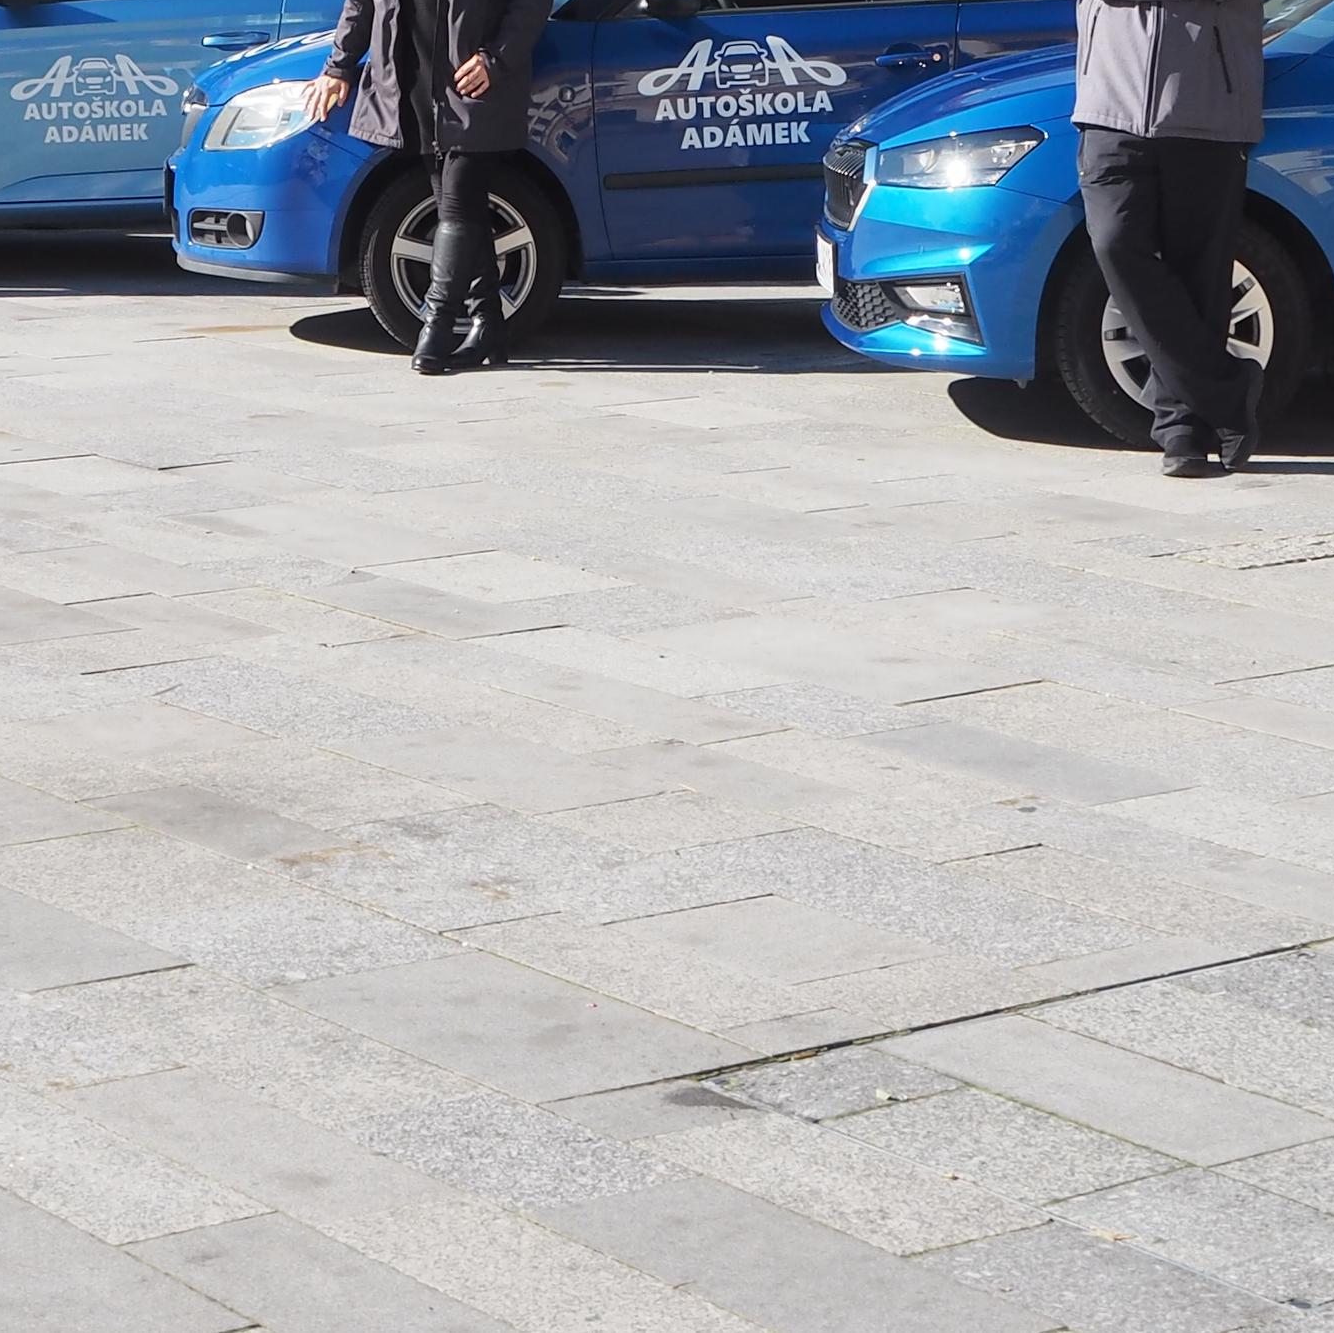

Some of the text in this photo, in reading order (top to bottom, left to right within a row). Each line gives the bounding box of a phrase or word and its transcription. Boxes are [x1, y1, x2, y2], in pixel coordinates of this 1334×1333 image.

[23, 96, 168, 121] AUTOŠKOLA
[654, 88, 833, 122] AUTOŠKOLA
[44, 120, 149, 144] ADÁMEK
[680, 118, 811, 150] ADÁMEK
